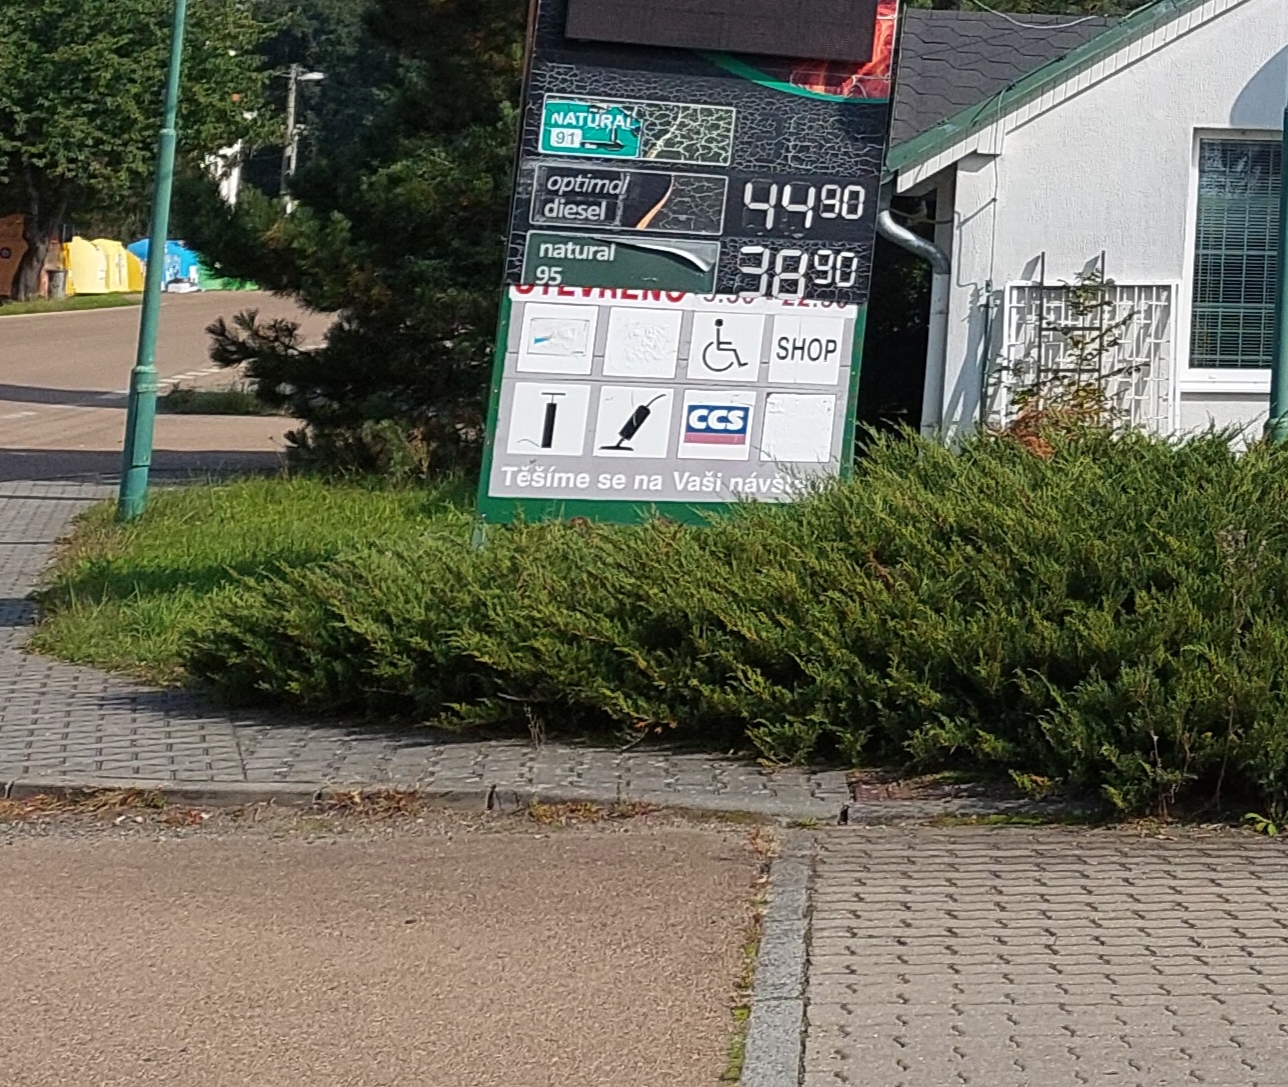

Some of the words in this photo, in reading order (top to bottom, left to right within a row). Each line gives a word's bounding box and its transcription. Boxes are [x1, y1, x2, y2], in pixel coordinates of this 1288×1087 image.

[551, 111, 635, 130] NATURAL
[555, 131, 576, 145] 91
[547, 174, 630, 195] optimal
[544, 198, 607, 221] diesel
[539, 241, 616, 261] natural
[535, 265, 563, 285] 95
[776, 336, 838, 362] SHOP
[688, 408, 745, 430] CCS
[501, 466, 590, 488] Těšíme
[597, 473, 626, 489] se
[633, 474, 663, 490] na
[673, 471, 722, 492] Vaši
